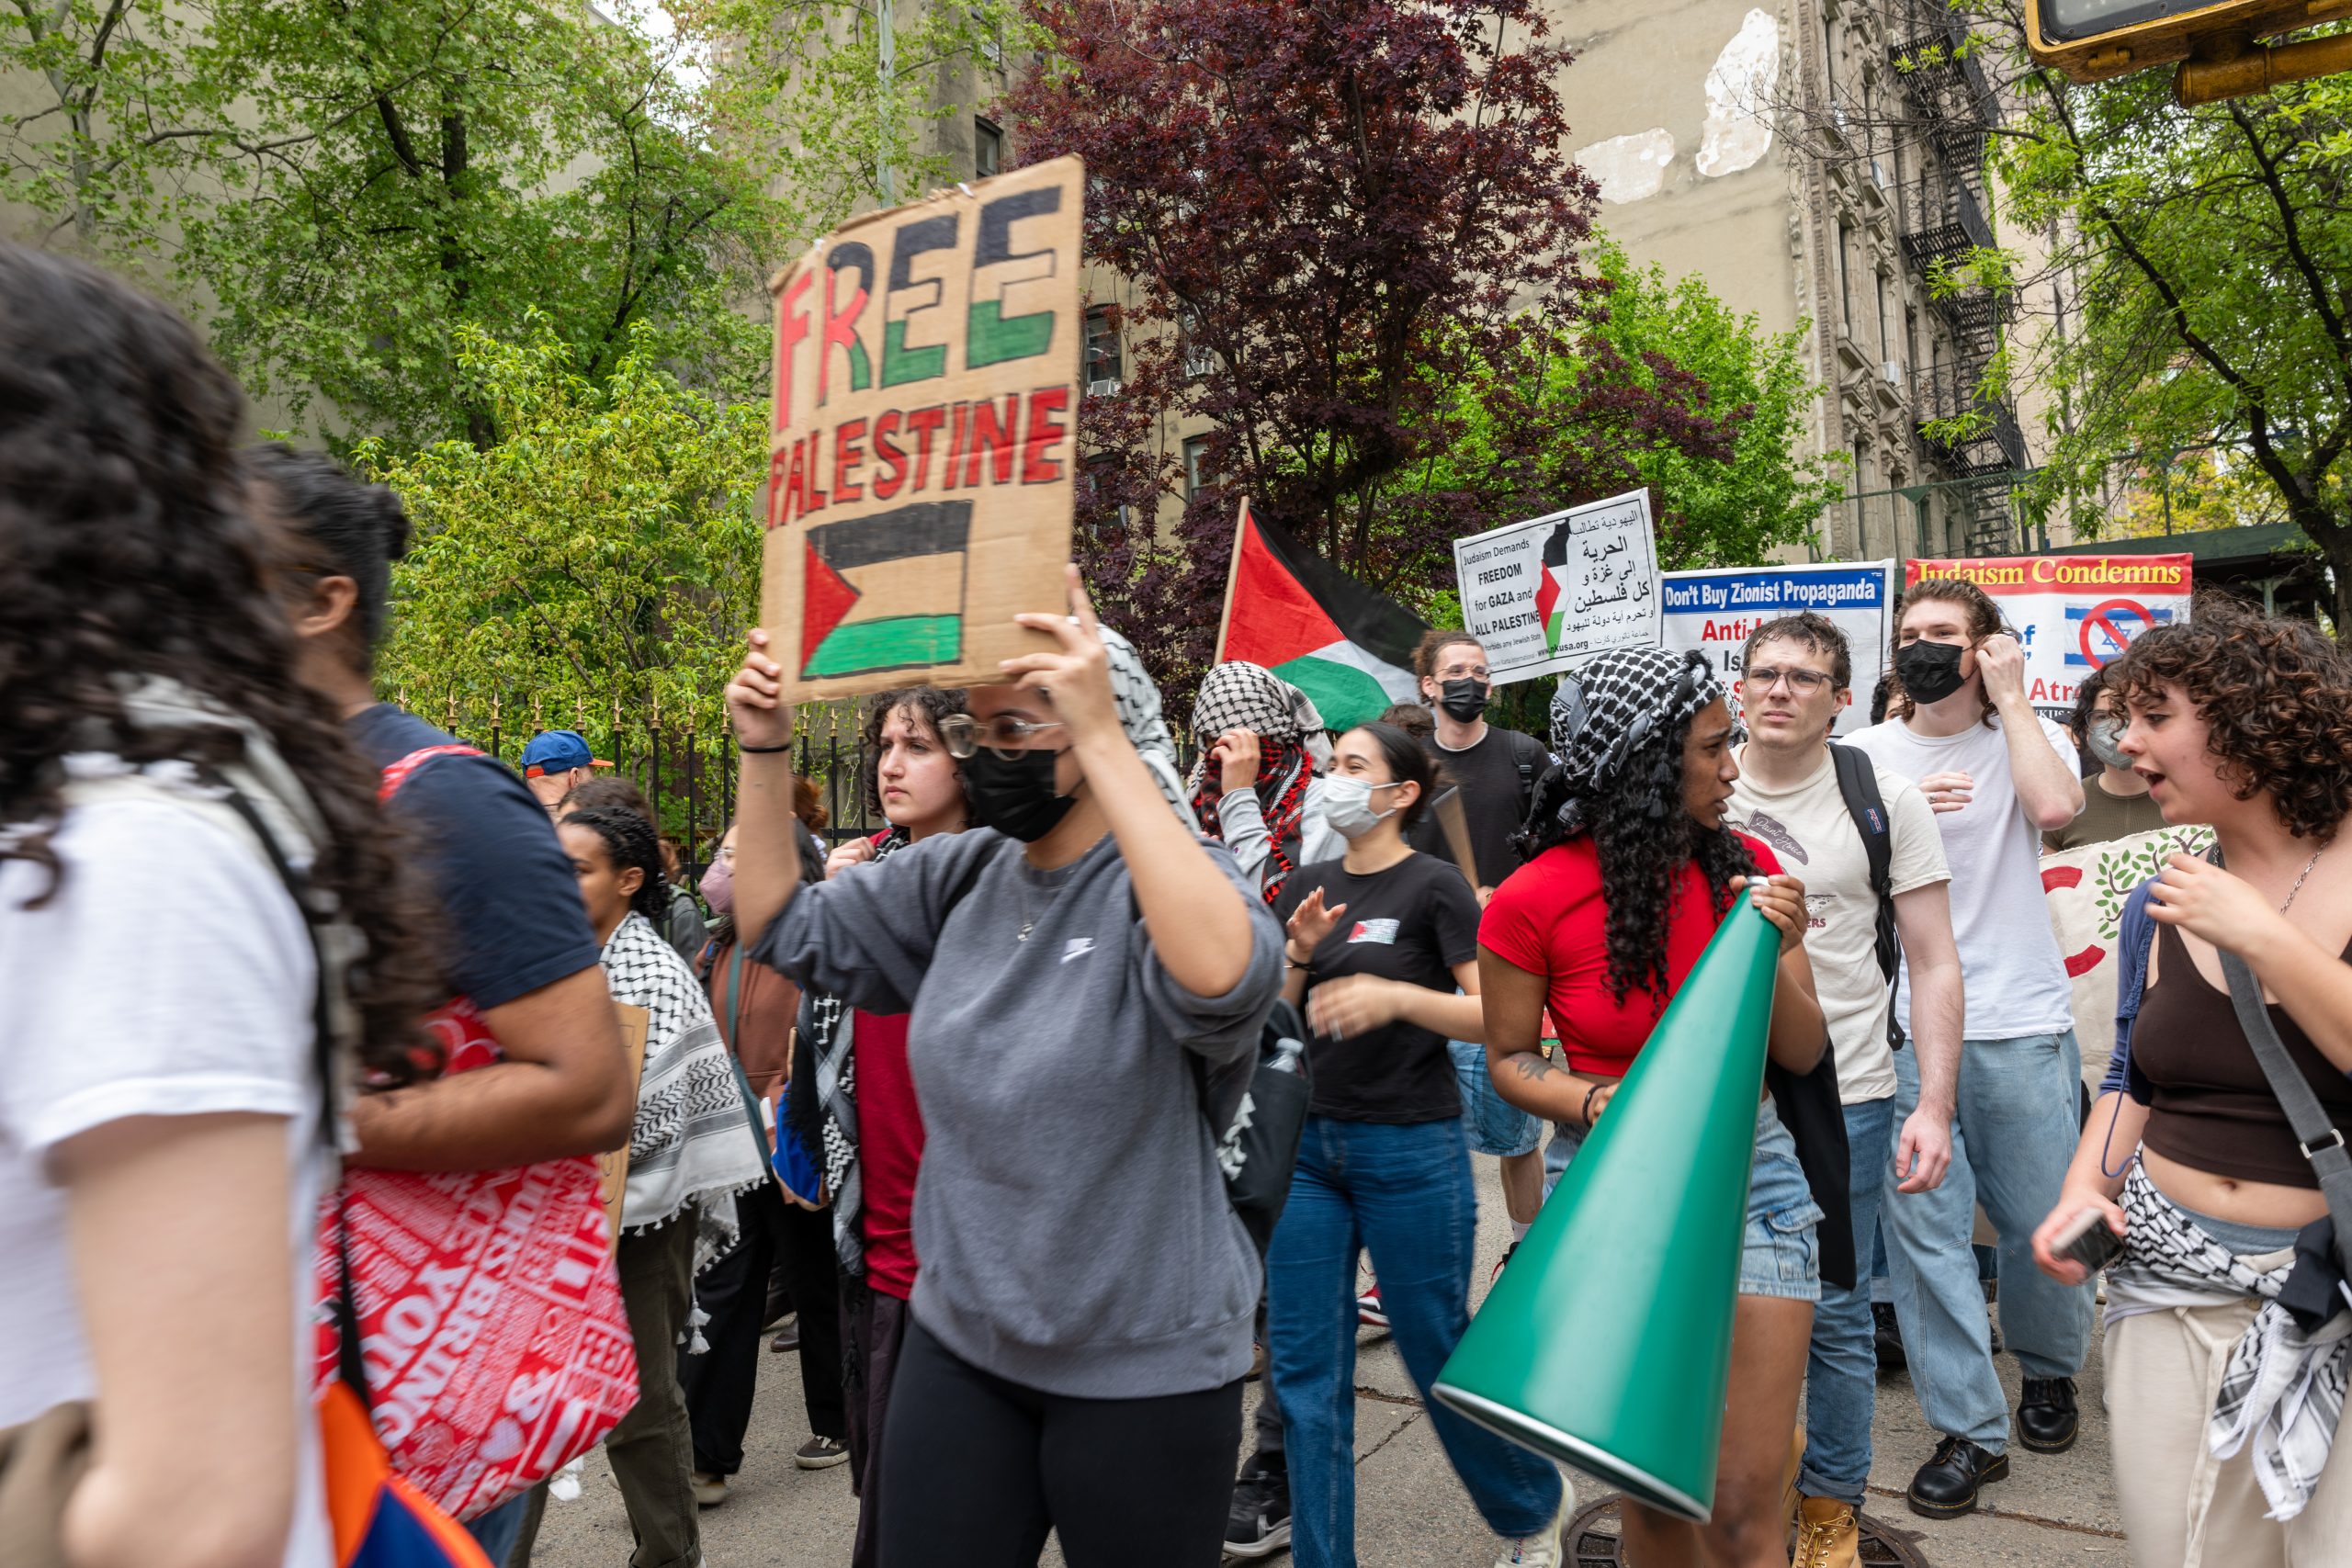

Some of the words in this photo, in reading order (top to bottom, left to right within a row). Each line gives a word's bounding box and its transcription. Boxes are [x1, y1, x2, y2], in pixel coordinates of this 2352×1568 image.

[776, 185, 1062, 433] FREE
[767, 384, 1069, 529] PALESTINE
[1464, 551, 1492, 566] Judaism
[1493, 538, 1530, 558] Demands
[1582, 535, 1628, 563] الحرية
[1477, 563, 1522, 585] FREEDOM
[2031, 558, 2181, 585] Condemns
[1475, 600, 1487, 612] for
[1488, 591, 1515, 607] GAZA
[1517, 586, 1532, 602] and
[1574, 582, 1628, 614] فلسطين
[1633, 581, 1650, 603] كل
[1702, 584, 1728, 610] Buy
[1731, 581, 1781, 604] Zionist
[1783, 578, 1875, 607] Propaganda
[1475, 623, 1490, 637] ALL
[1492, 610, 1540, 632] PALESTINE
[370, 1269, 503, 1451] BRING
